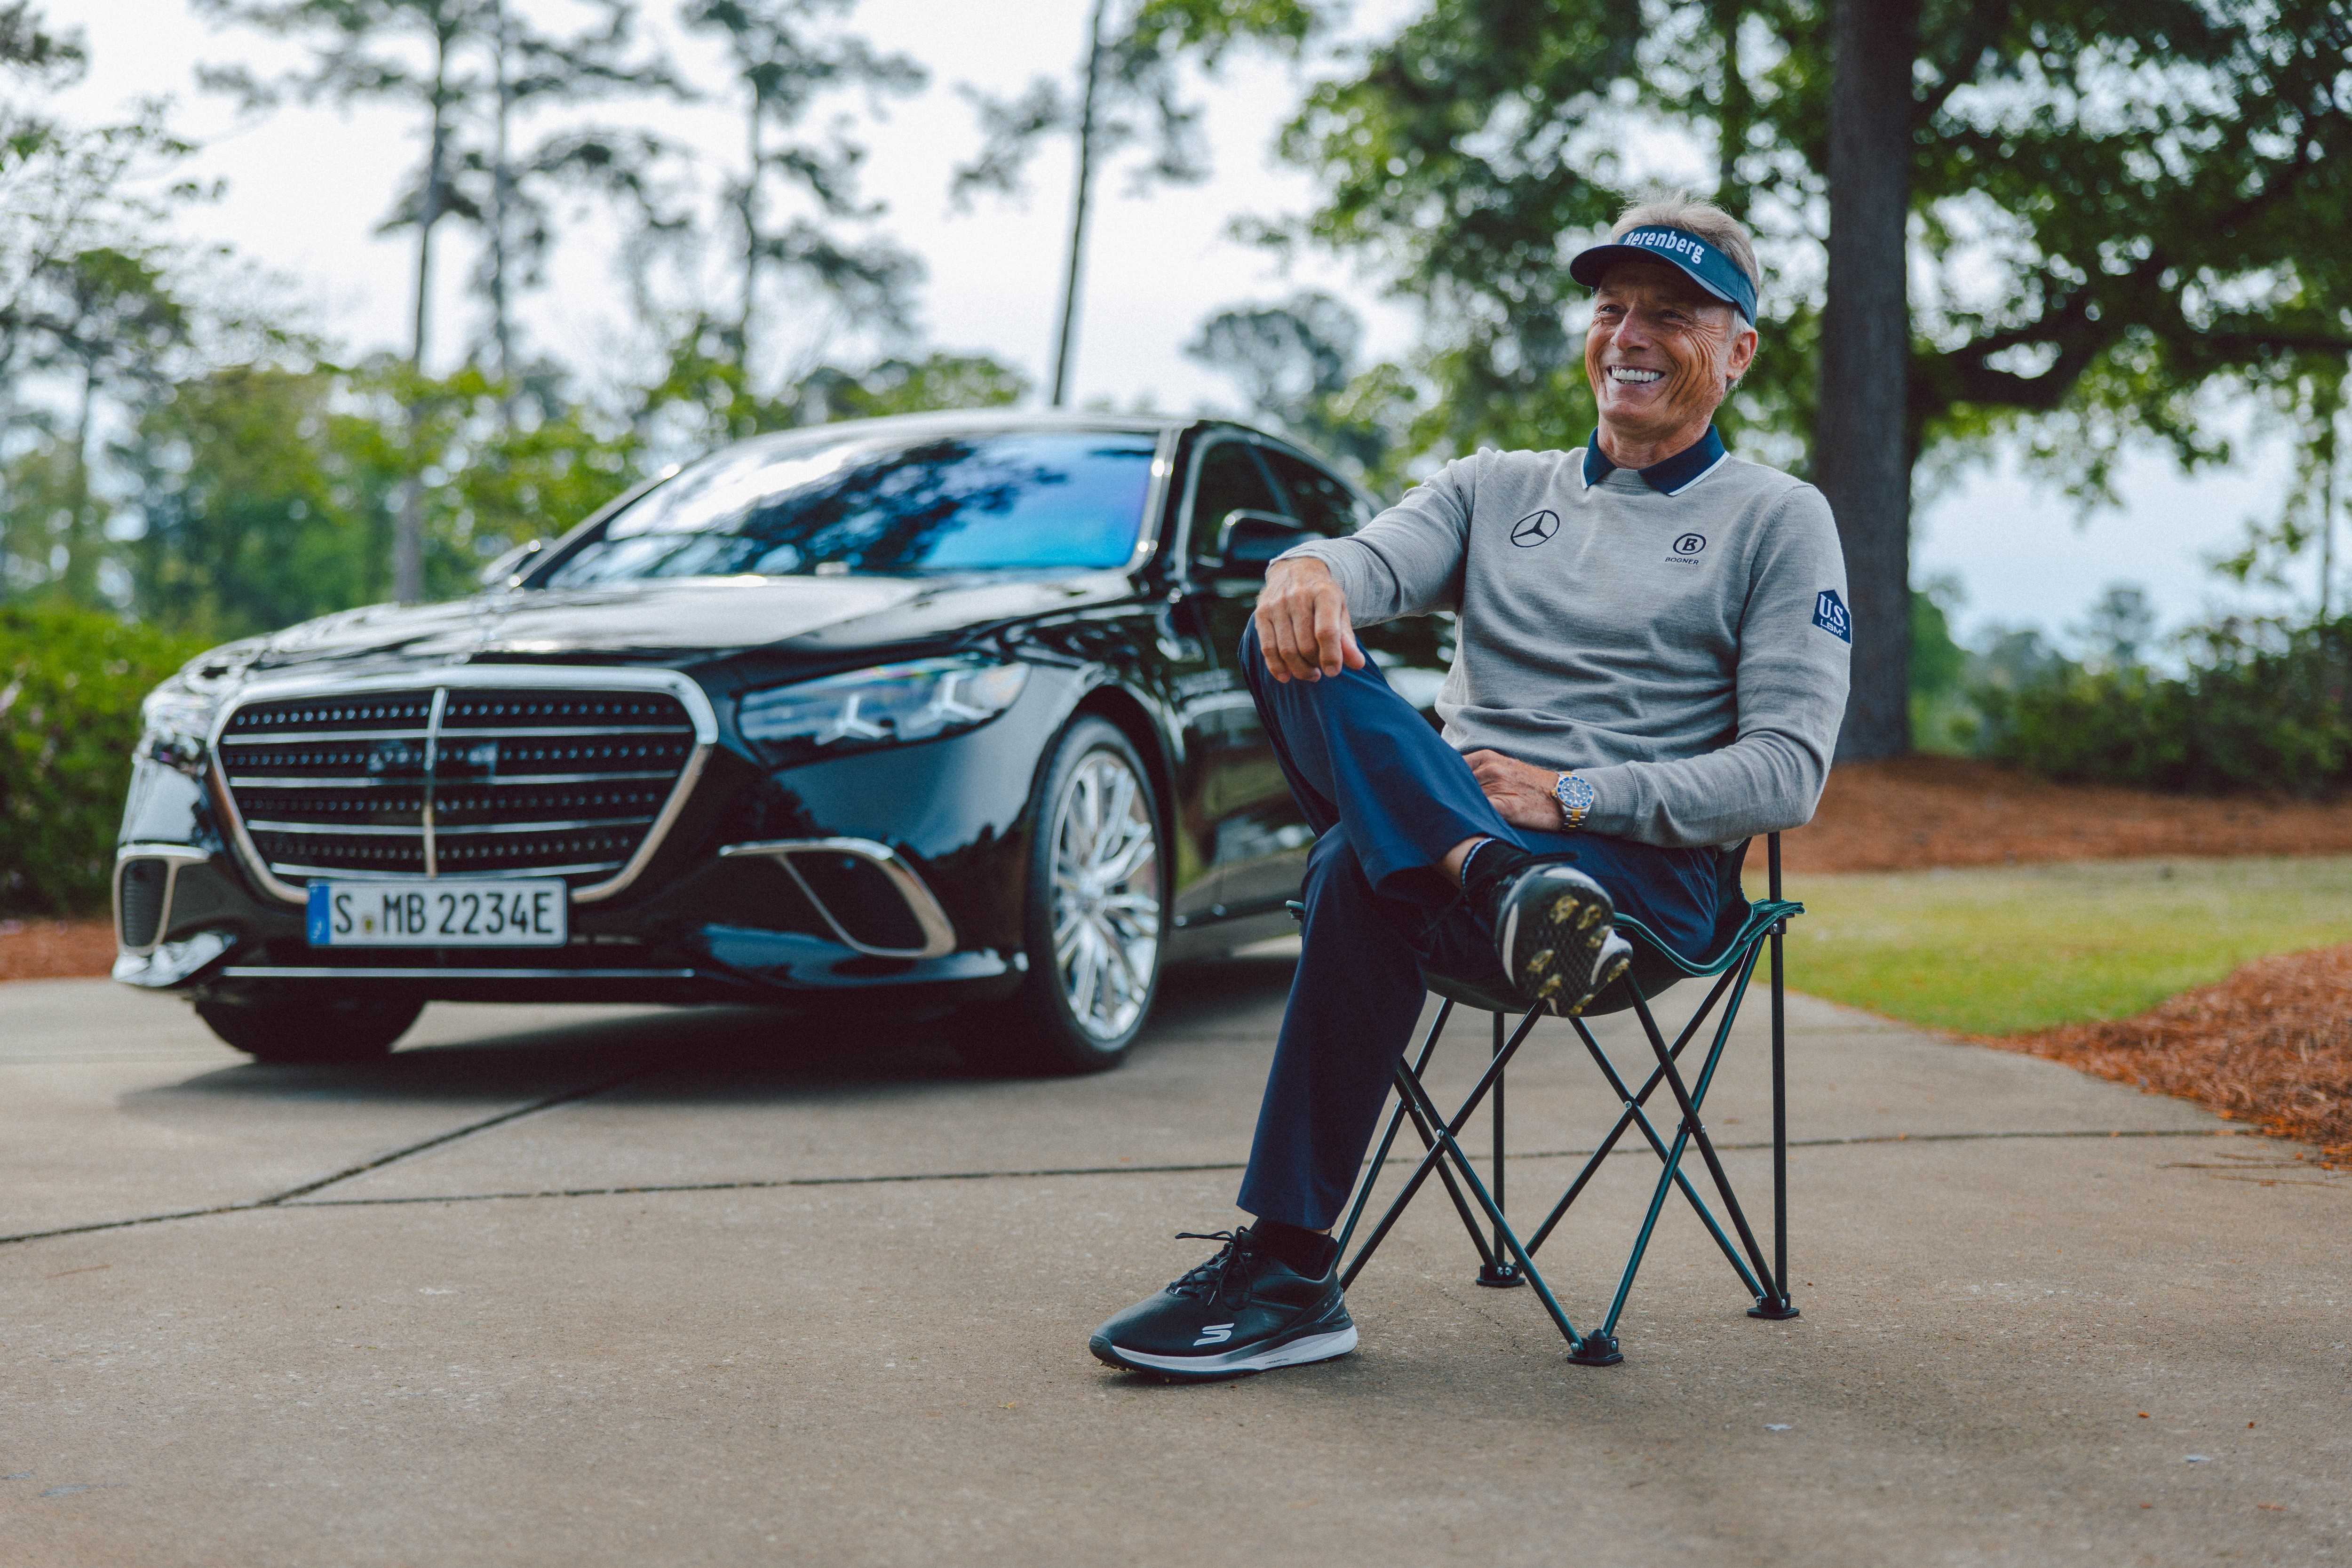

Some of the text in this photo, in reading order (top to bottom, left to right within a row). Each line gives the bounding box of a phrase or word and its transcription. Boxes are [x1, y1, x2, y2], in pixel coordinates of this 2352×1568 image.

[1623, 231, 1705, 264] Berenberg
[1682, 538, 1698, 551] B
[1819, 594, 1846, 630] U.S.
[335, 894, 353, 934] S
[383, 893, 426, 934] MB
[438, 893, 553, 934] 2234E
